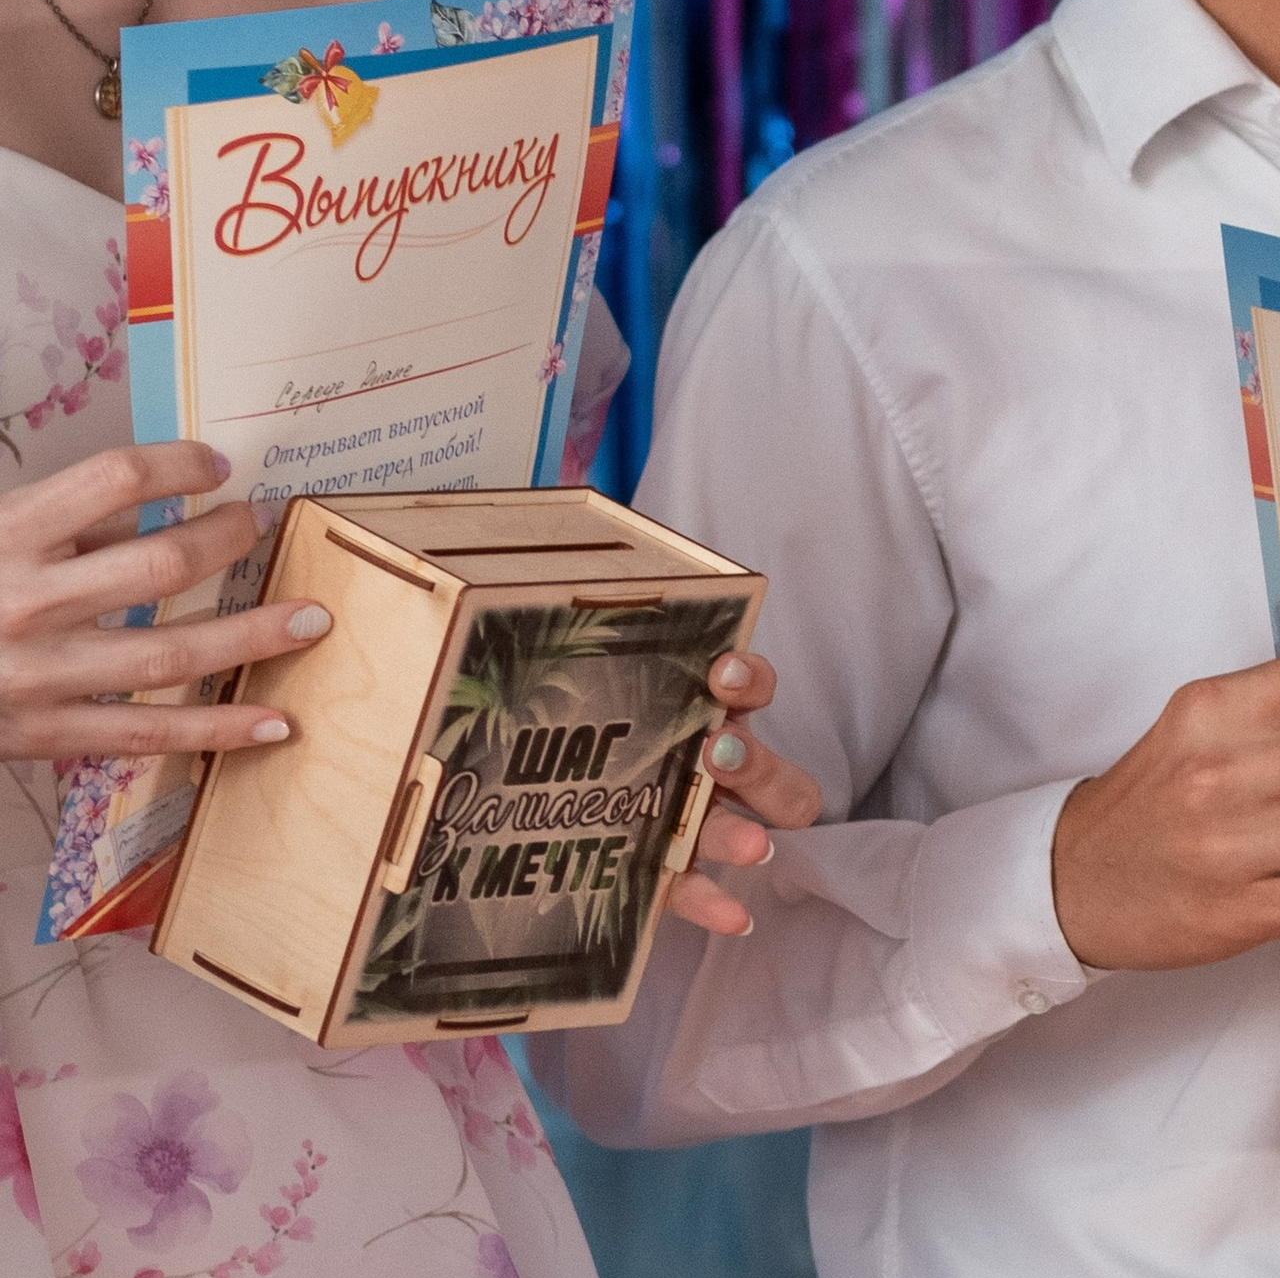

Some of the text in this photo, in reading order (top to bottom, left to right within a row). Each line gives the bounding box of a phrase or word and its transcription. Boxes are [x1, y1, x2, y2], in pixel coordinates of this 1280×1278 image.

[214, 132, 559, 283] Выпускнику
[247, 482, 292, 503] Сто
[362, 456, 414, 487] перед
[419, 427, 483, 468] тобой!
[263, 391, 485, 468] Открывает выпускной
[503, 722, 633, 786] ШАГ
[418, 770, 665, 877] За шагом
[431, 835, 629, 903] К МЕЧТЕ
